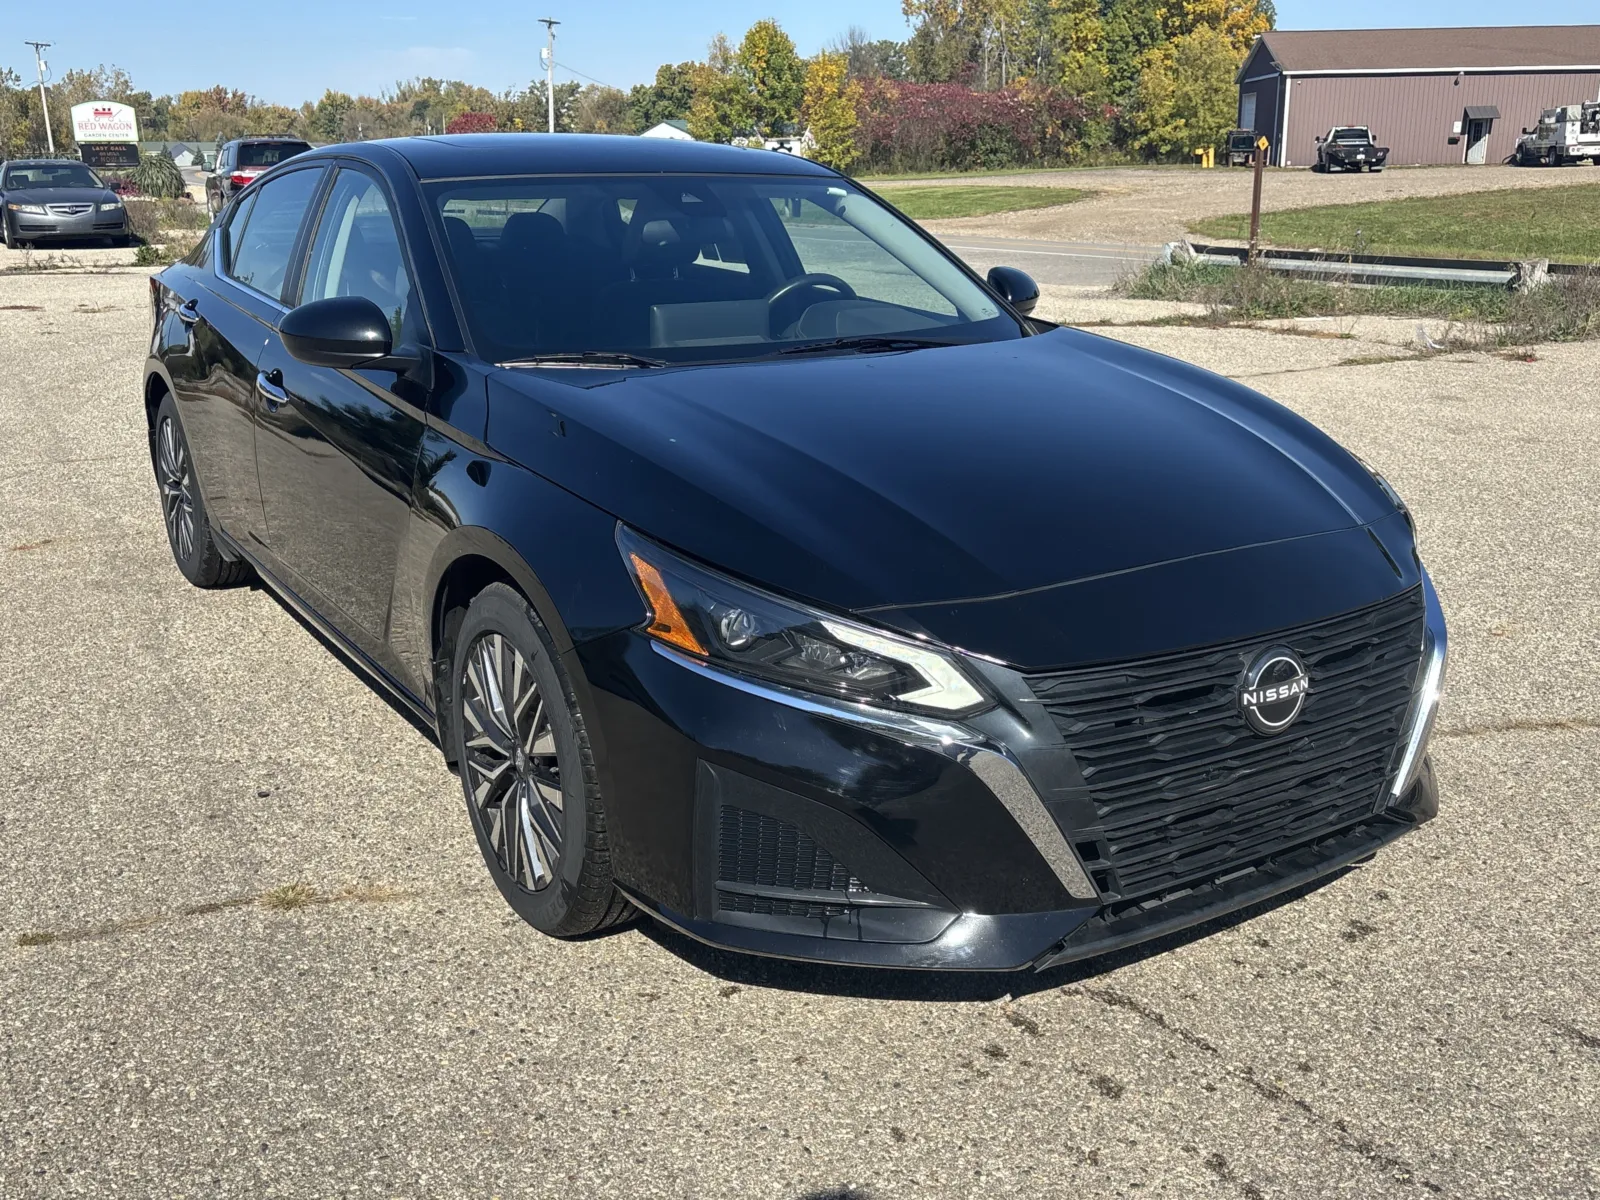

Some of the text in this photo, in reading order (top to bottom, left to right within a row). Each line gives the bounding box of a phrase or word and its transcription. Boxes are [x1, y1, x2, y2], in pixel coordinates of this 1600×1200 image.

[77, 122, 132, 130] RED WAGON
[1243, 676, 1309, 705] NISSAN
